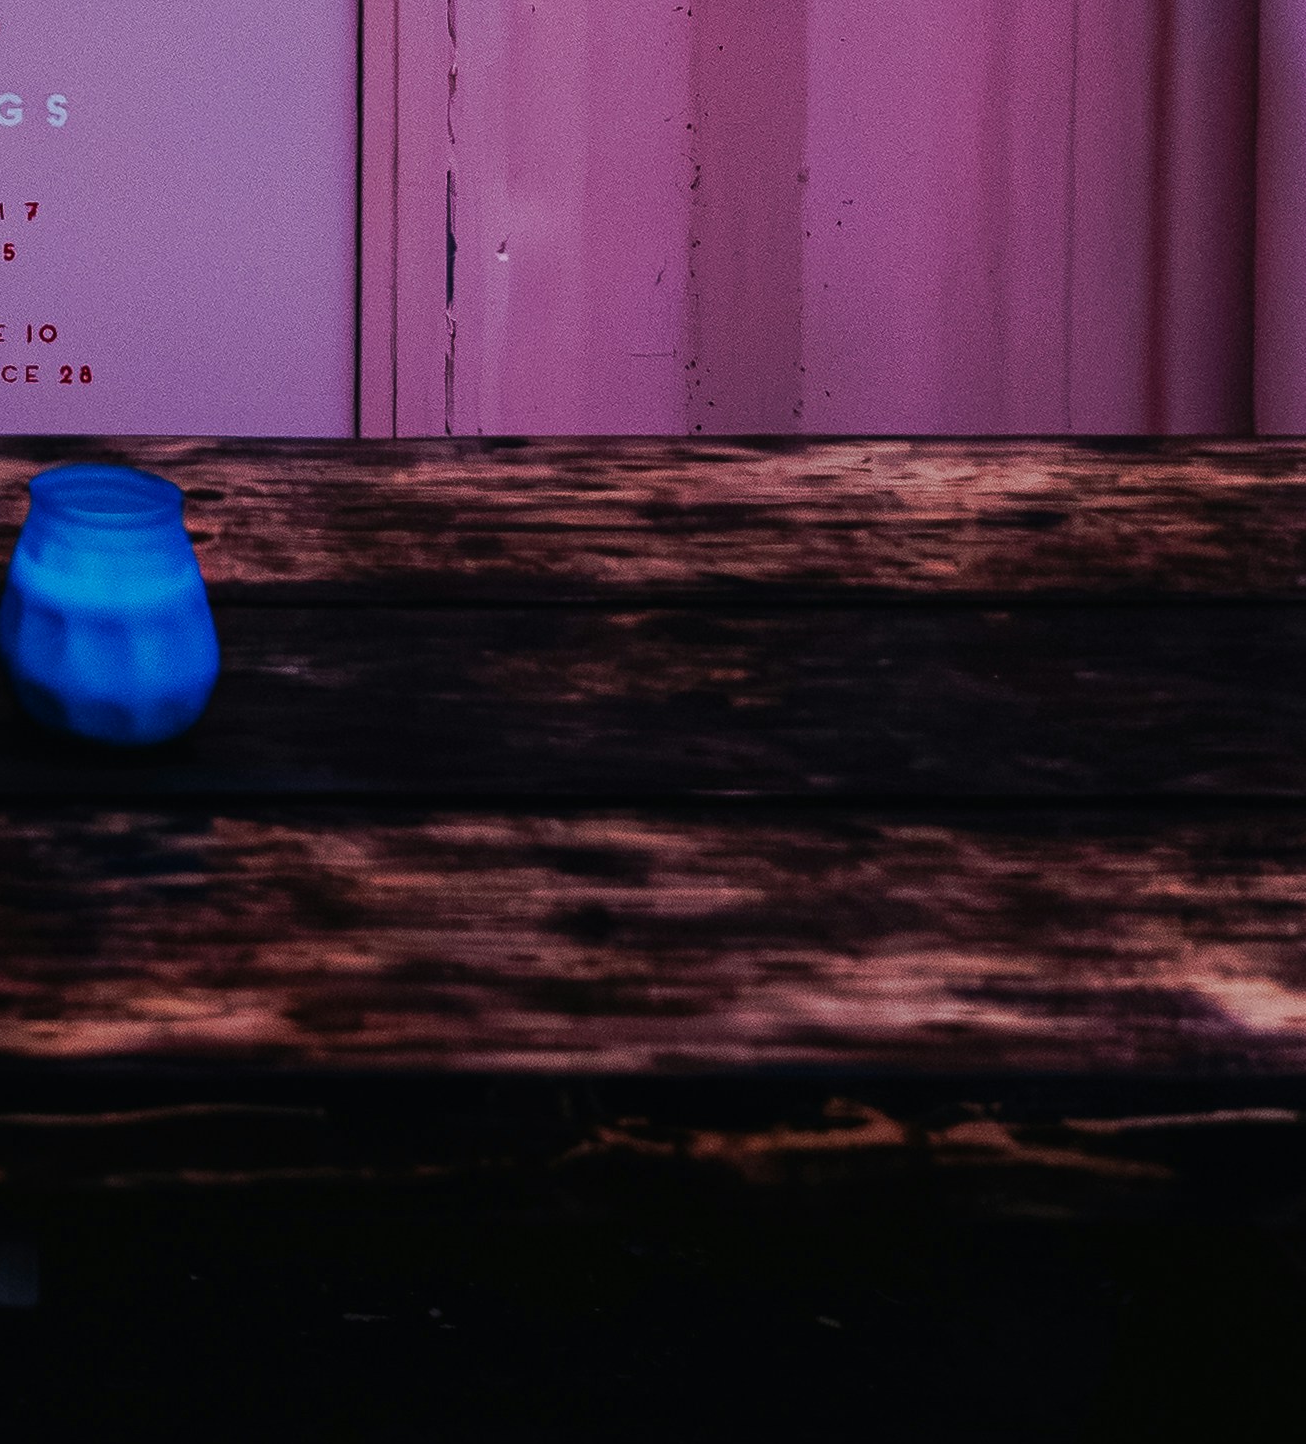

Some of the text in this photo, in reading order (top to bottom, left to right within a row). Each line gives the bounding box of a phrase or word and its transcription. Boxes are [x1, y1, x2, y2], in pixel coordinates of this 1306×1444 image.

[26, 201, 40, 222] 7
[26, 324, 58, 344] 10
[58, 366, 93, 385] 28
